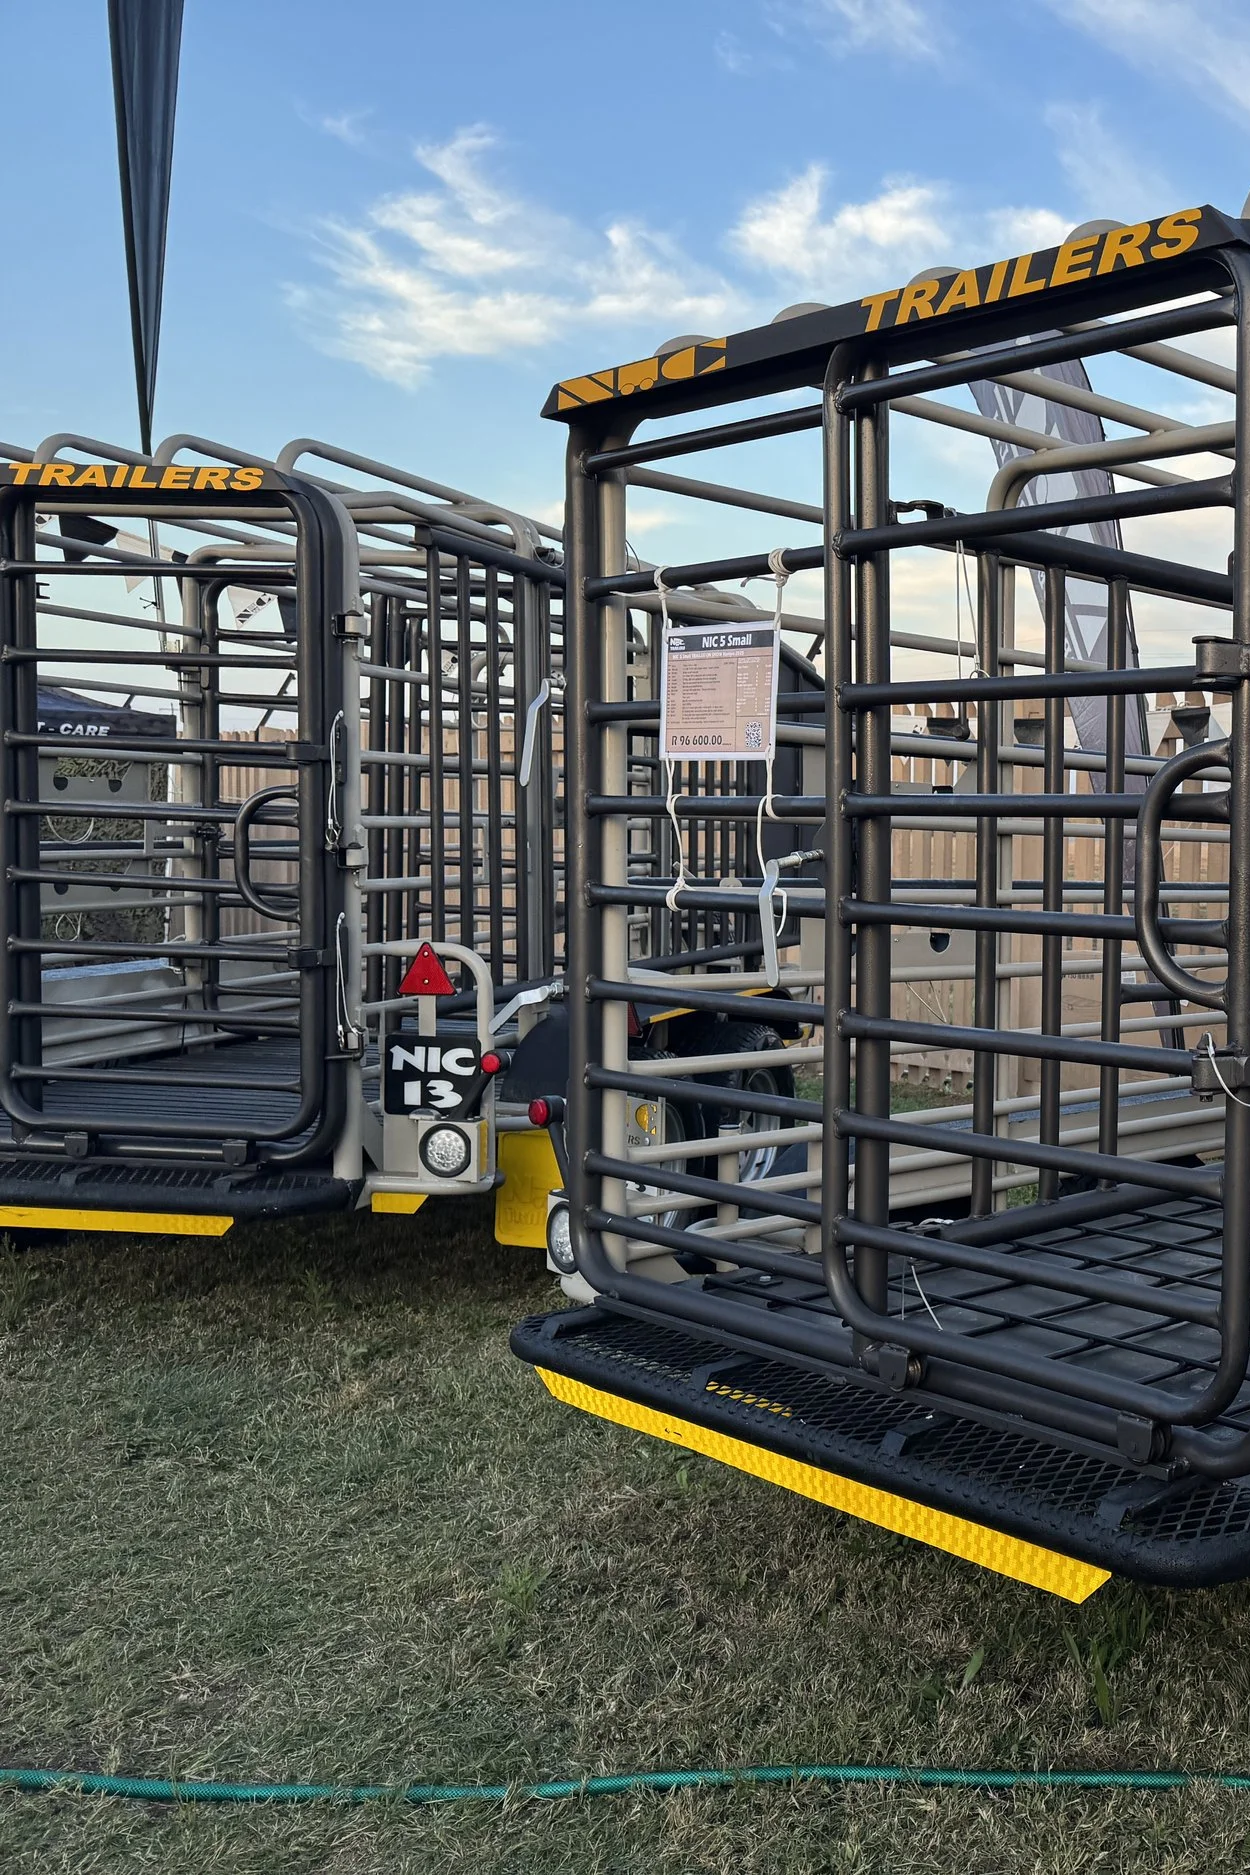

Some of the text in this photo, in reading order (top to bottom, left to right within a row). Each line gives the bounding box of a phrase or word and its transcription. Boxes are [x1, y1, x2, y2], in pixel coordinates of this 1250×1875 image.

[860, 206, 1203, 333] TRAILERS
[8, 462, 265, 491] TRAILERS
[702, 633, 752, 648] NIC 5 Small
[59, 723, 110, 737] CARE
[671, 735, 723, 746] R 96 600.00
[389, 1044, 477, 1076] NIC
[403, 1080, 463, 1108] 13
